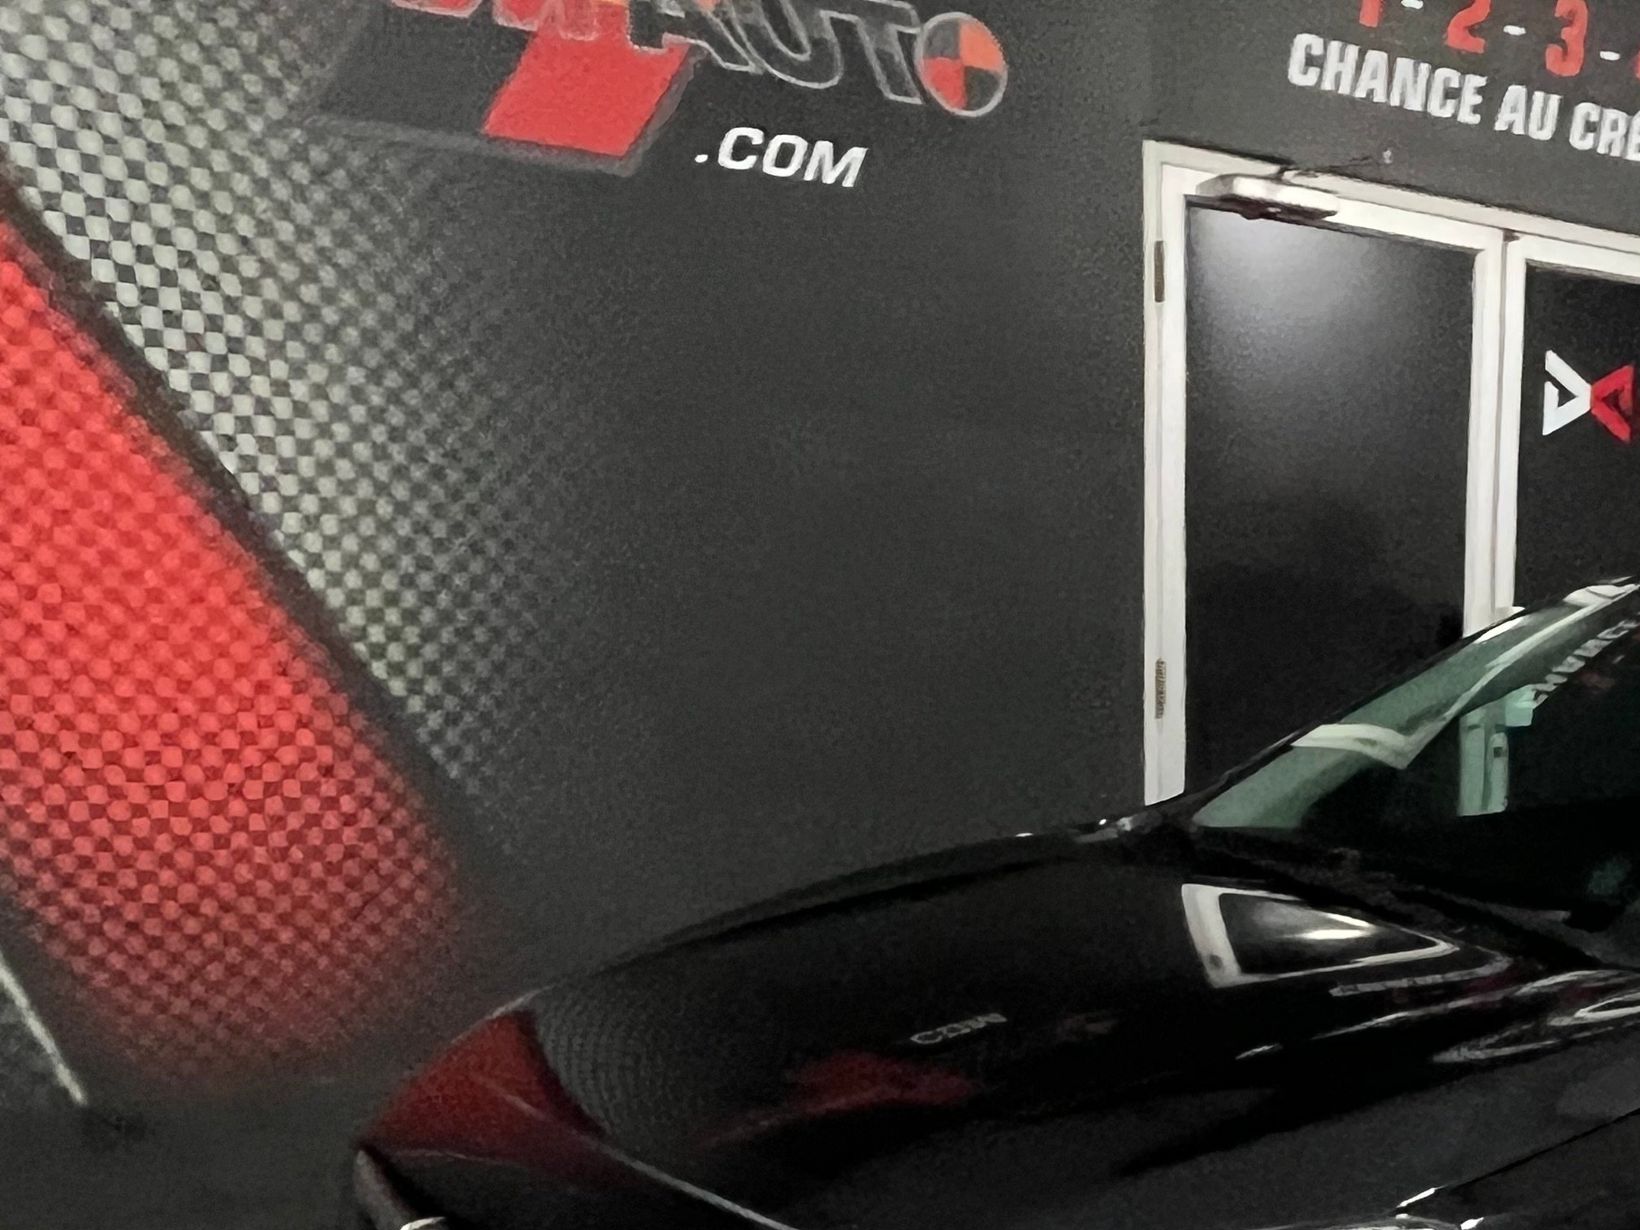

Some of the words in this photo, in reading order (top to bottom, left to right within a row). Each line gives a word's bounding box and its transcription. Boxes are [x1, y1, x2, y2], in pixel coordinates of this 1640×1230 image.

[1287, 32, 1488, 126] CHANCE
[1494, 84, 1563, 141] AU
[694, 126, 868, 188] .COM
